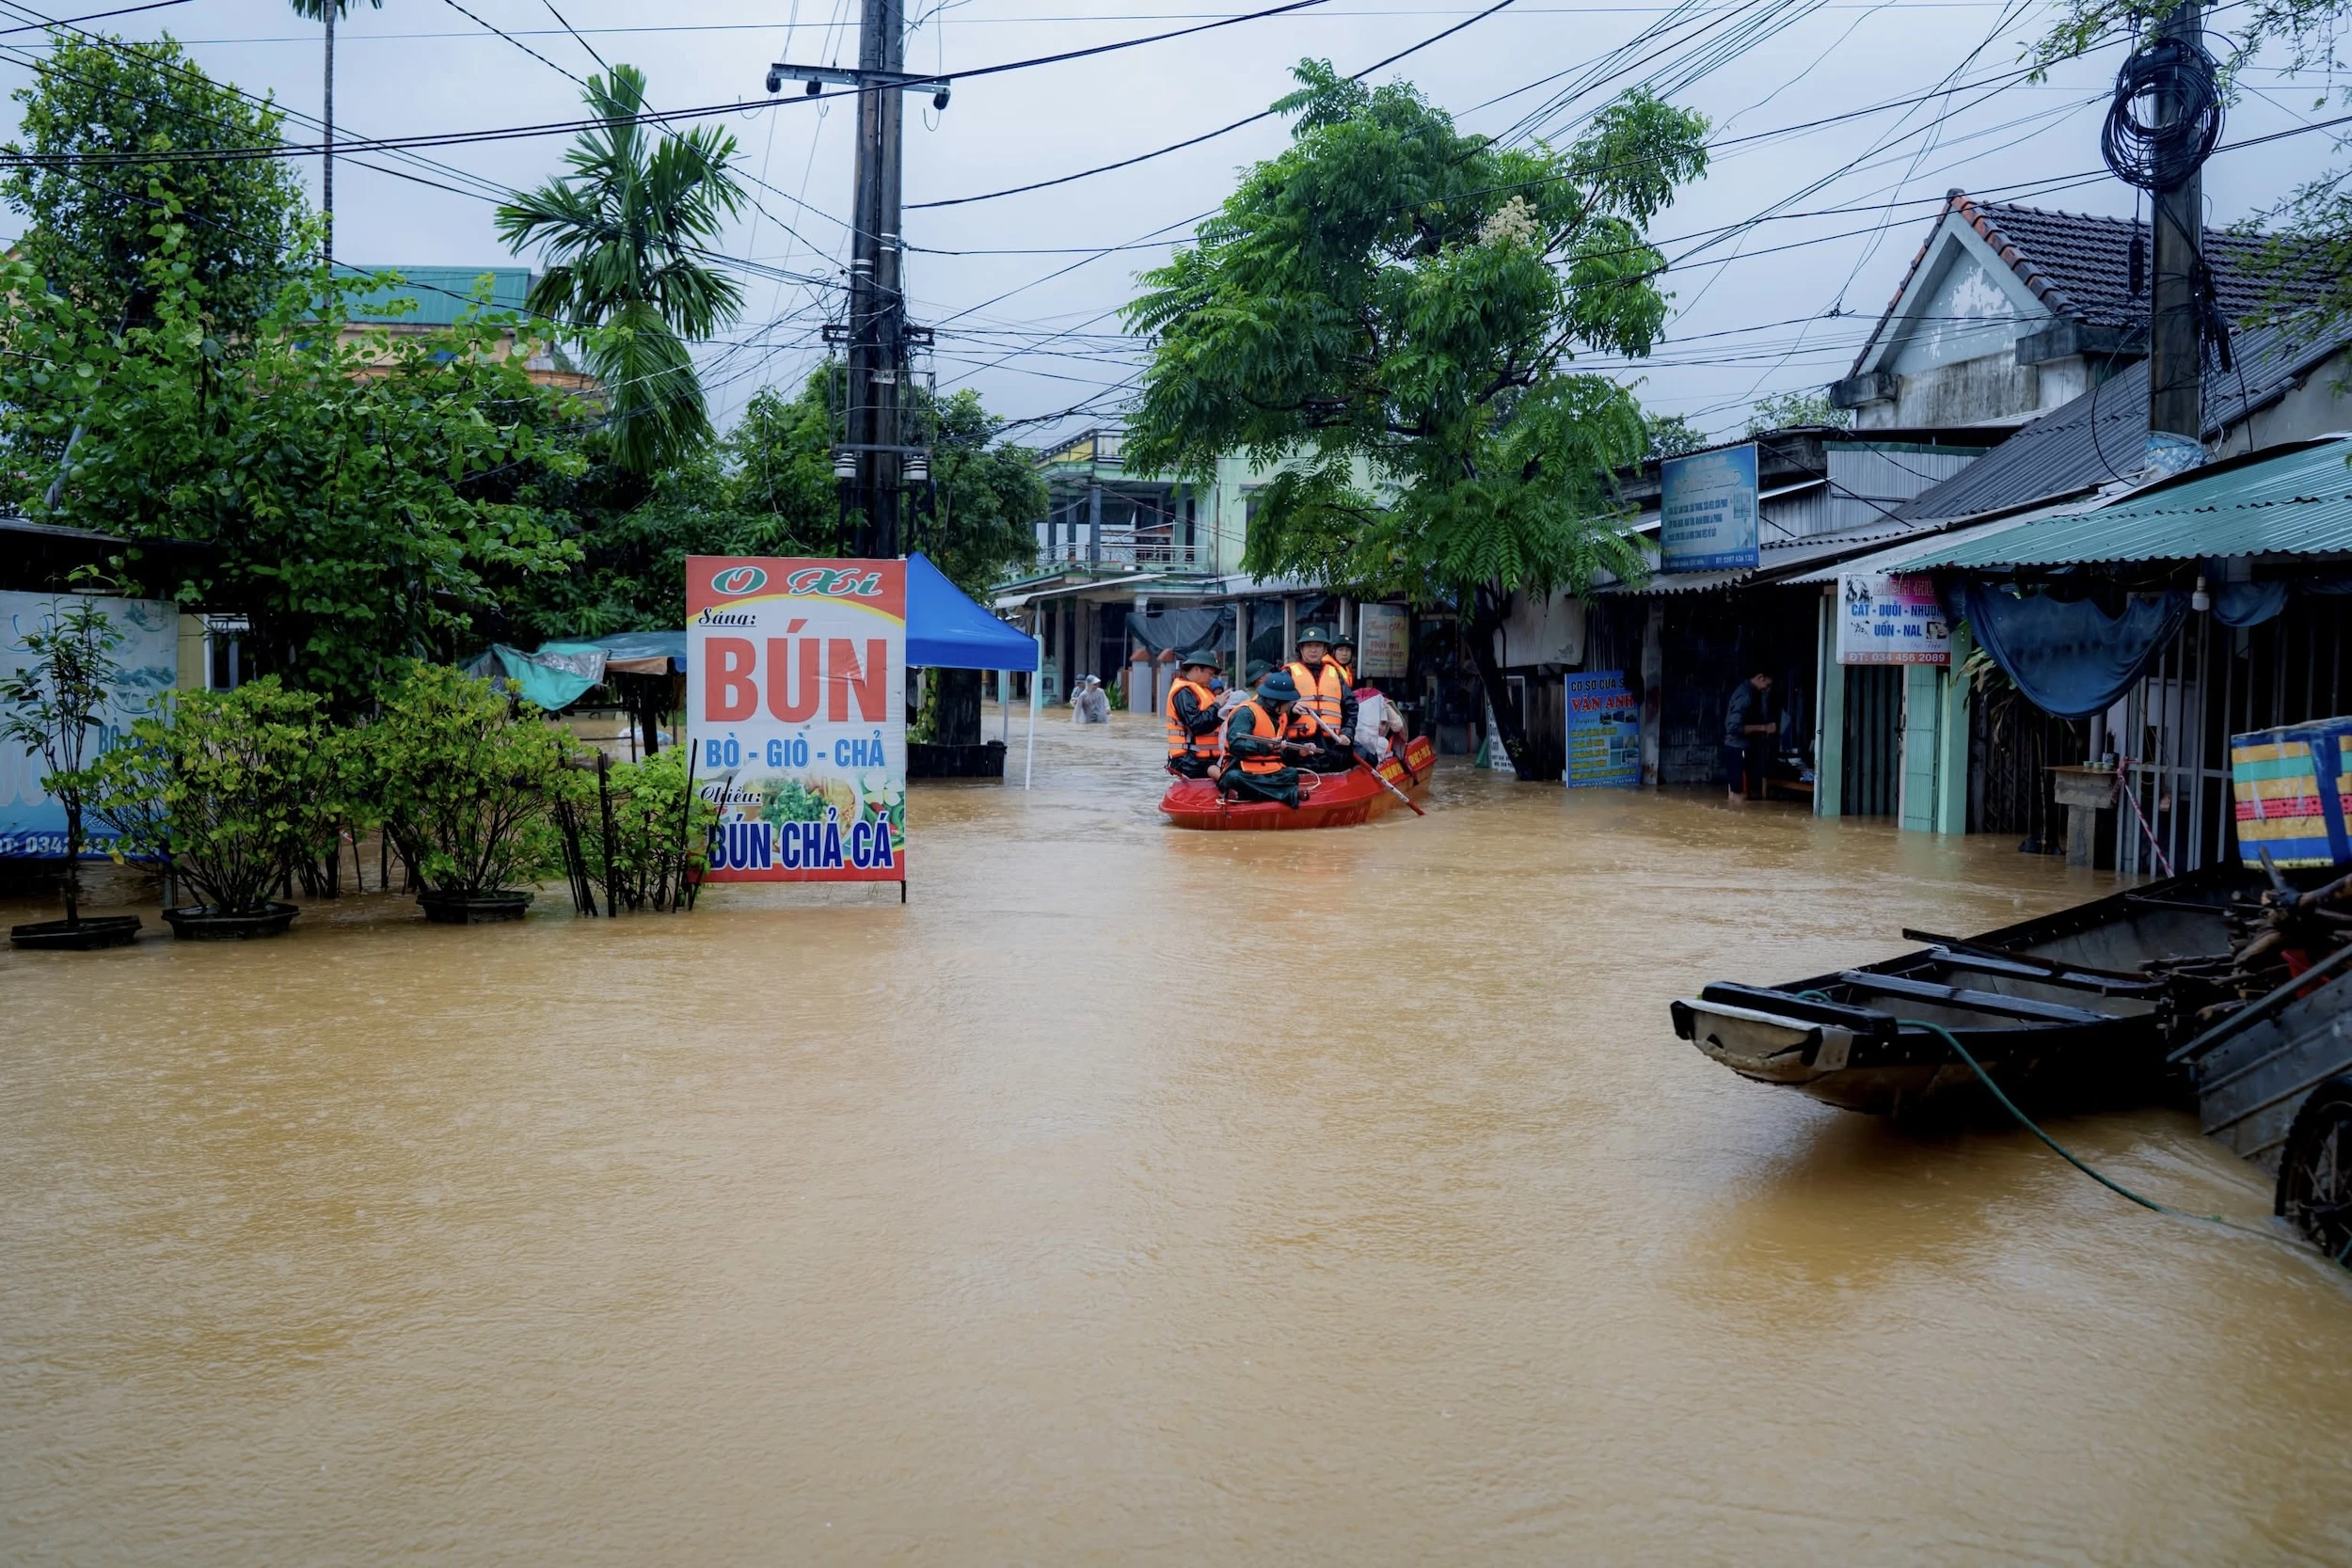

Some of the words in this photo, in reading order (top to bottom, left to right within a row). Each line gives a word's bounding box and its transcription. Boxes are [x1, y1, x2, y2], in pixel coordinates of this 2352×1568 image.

[711, 566, 768, 595] O
[698, 608, 756, 627] Sáng:
[705, 618, 887, 722] BÚN
[1896, 653, 1915, 661] 456
[1919, 653, 1945, 661] 2089
[706, 732, 739, 768] BÒ
[767, 733, 808, 768] GIÒ
[834, 730, 885, 767] CHẢ
[708, 814, 771, 868] BÚN
[781, 807, 844, 868] CHẢ
[852, 812, 894, 868] CÁ
